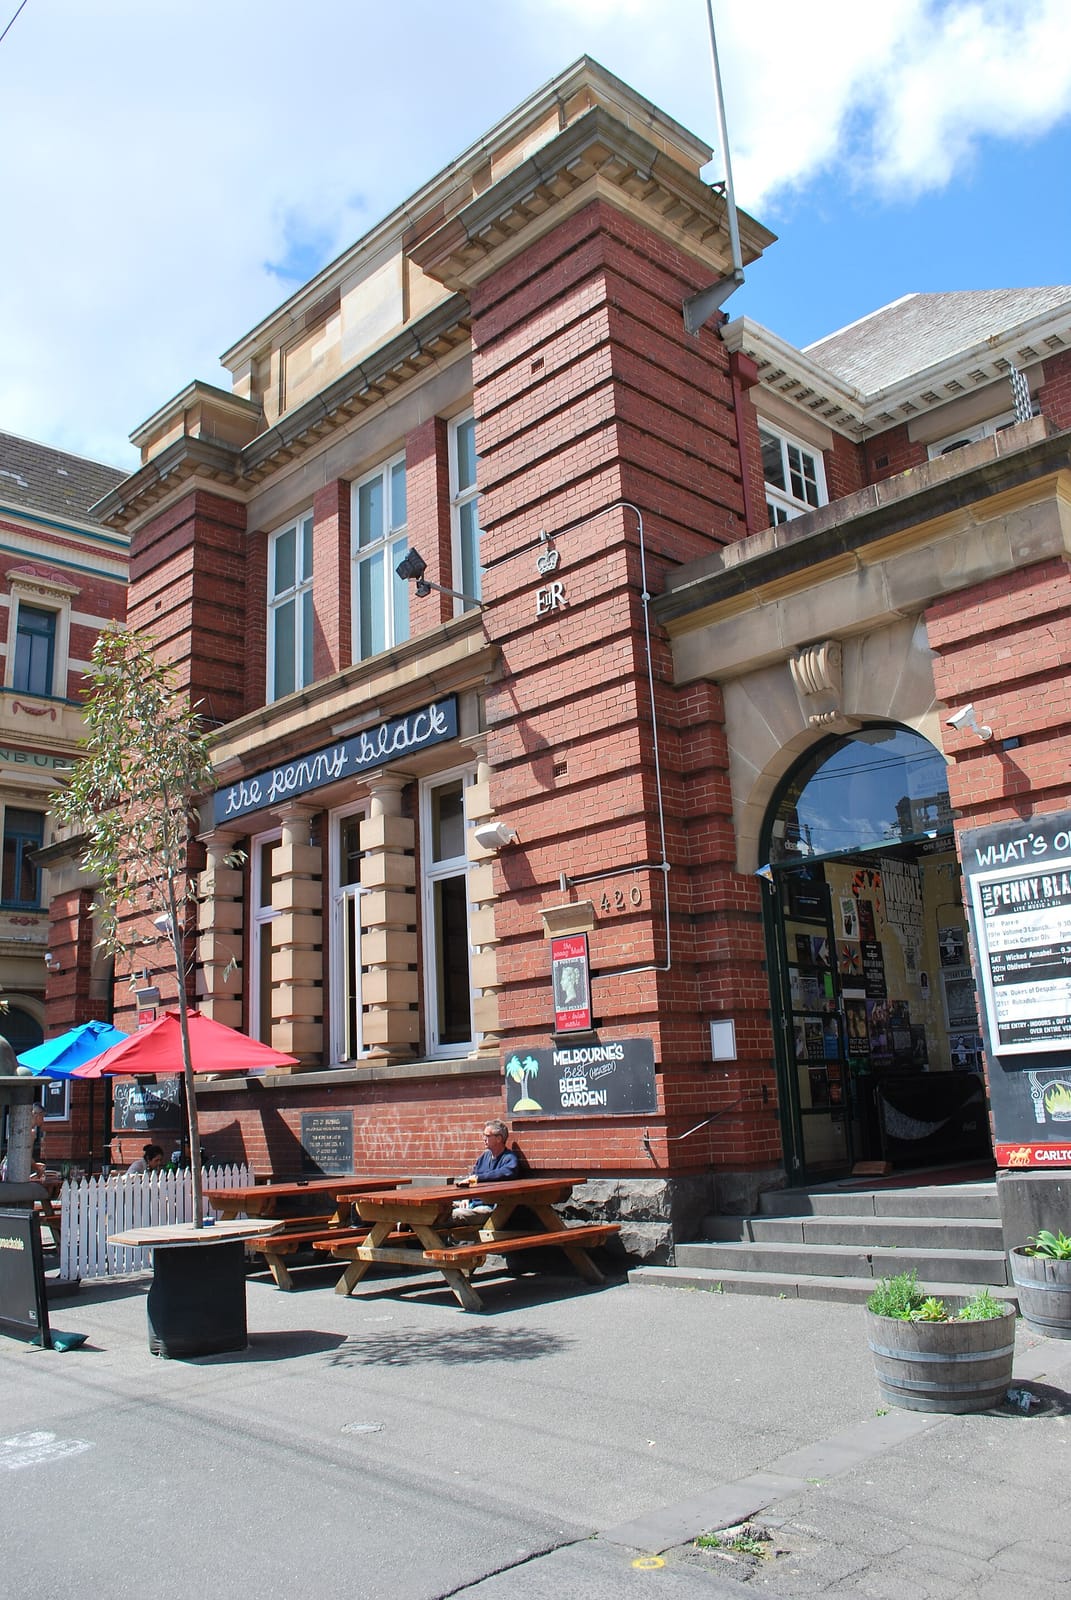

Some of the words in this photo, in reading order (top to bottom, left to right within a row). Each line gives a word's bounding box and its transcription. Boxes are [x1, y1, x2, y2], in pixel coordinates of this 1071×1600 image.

[225, 780, 262, 815] the
[267, 745, 348, 802] penny
[356, 703, 448, 764] black
[975, 832, 1048, 867] WHAT'S
[600, 886, 642, 911] 420
[992, 878, 1039, 906] PENNY
[1041, 873, 1071, 898] BLA
[1012, 905, 1026, 913] LIVE
[991, 955, 1002, 964] SAT
[993, 974, 1005, 983] OCT
[1029, 1027, 1043, 1035] OVER
[552, 1042, 625, 1066] MELBOURNE'S
[559, 1076, 588, 1093] BEER
[560, 1089, 607, 1107] GARDEN!
